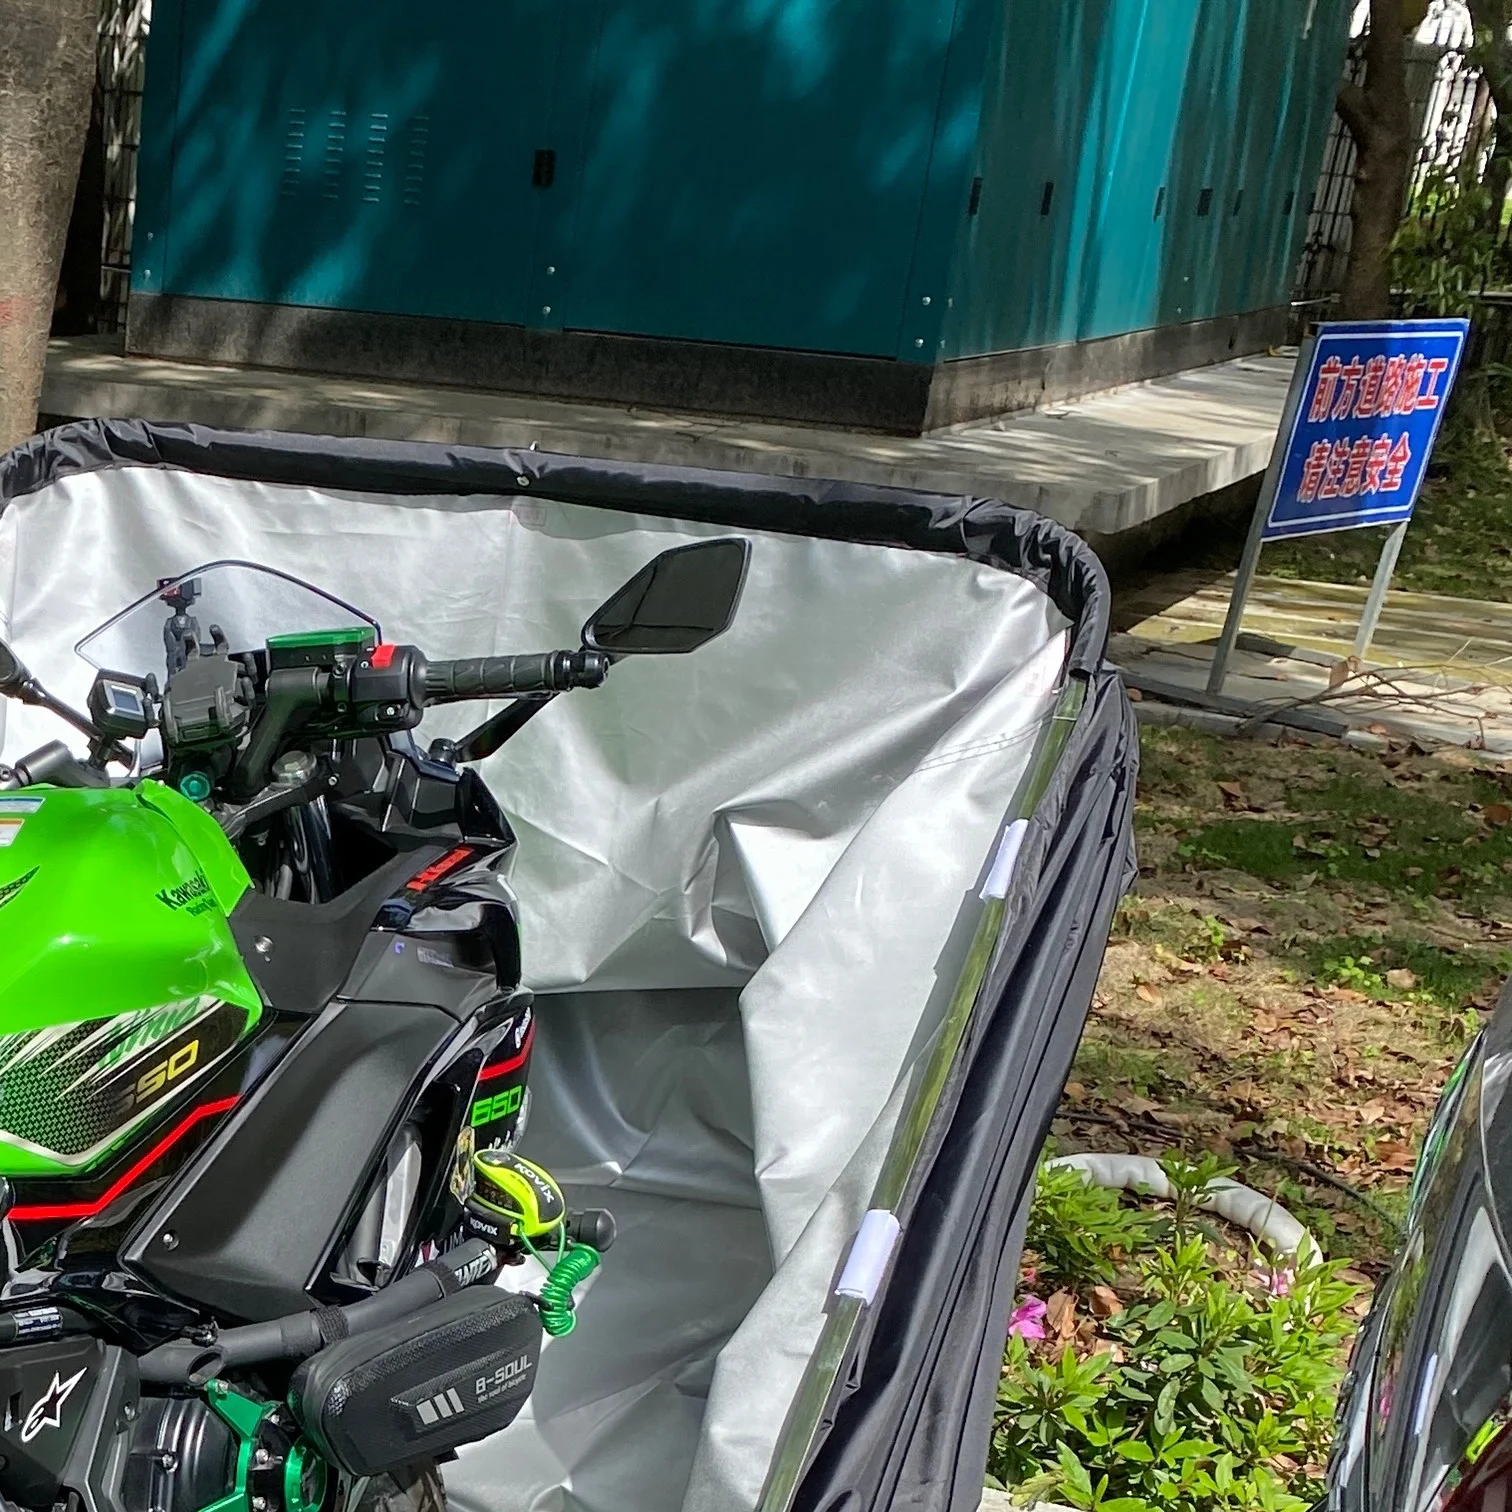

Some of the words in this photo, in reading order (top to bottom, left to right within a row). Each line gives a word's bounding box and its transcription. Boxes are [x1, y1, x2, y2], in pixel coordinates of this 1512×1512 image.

[1307, 353, 1448, 423] 前方道路施工
[1296, 431, 1411, 503] 请注意安全
[471, 1085, 523, 1127] 650
[475, 1354, 533, 1395] B-SOUL
